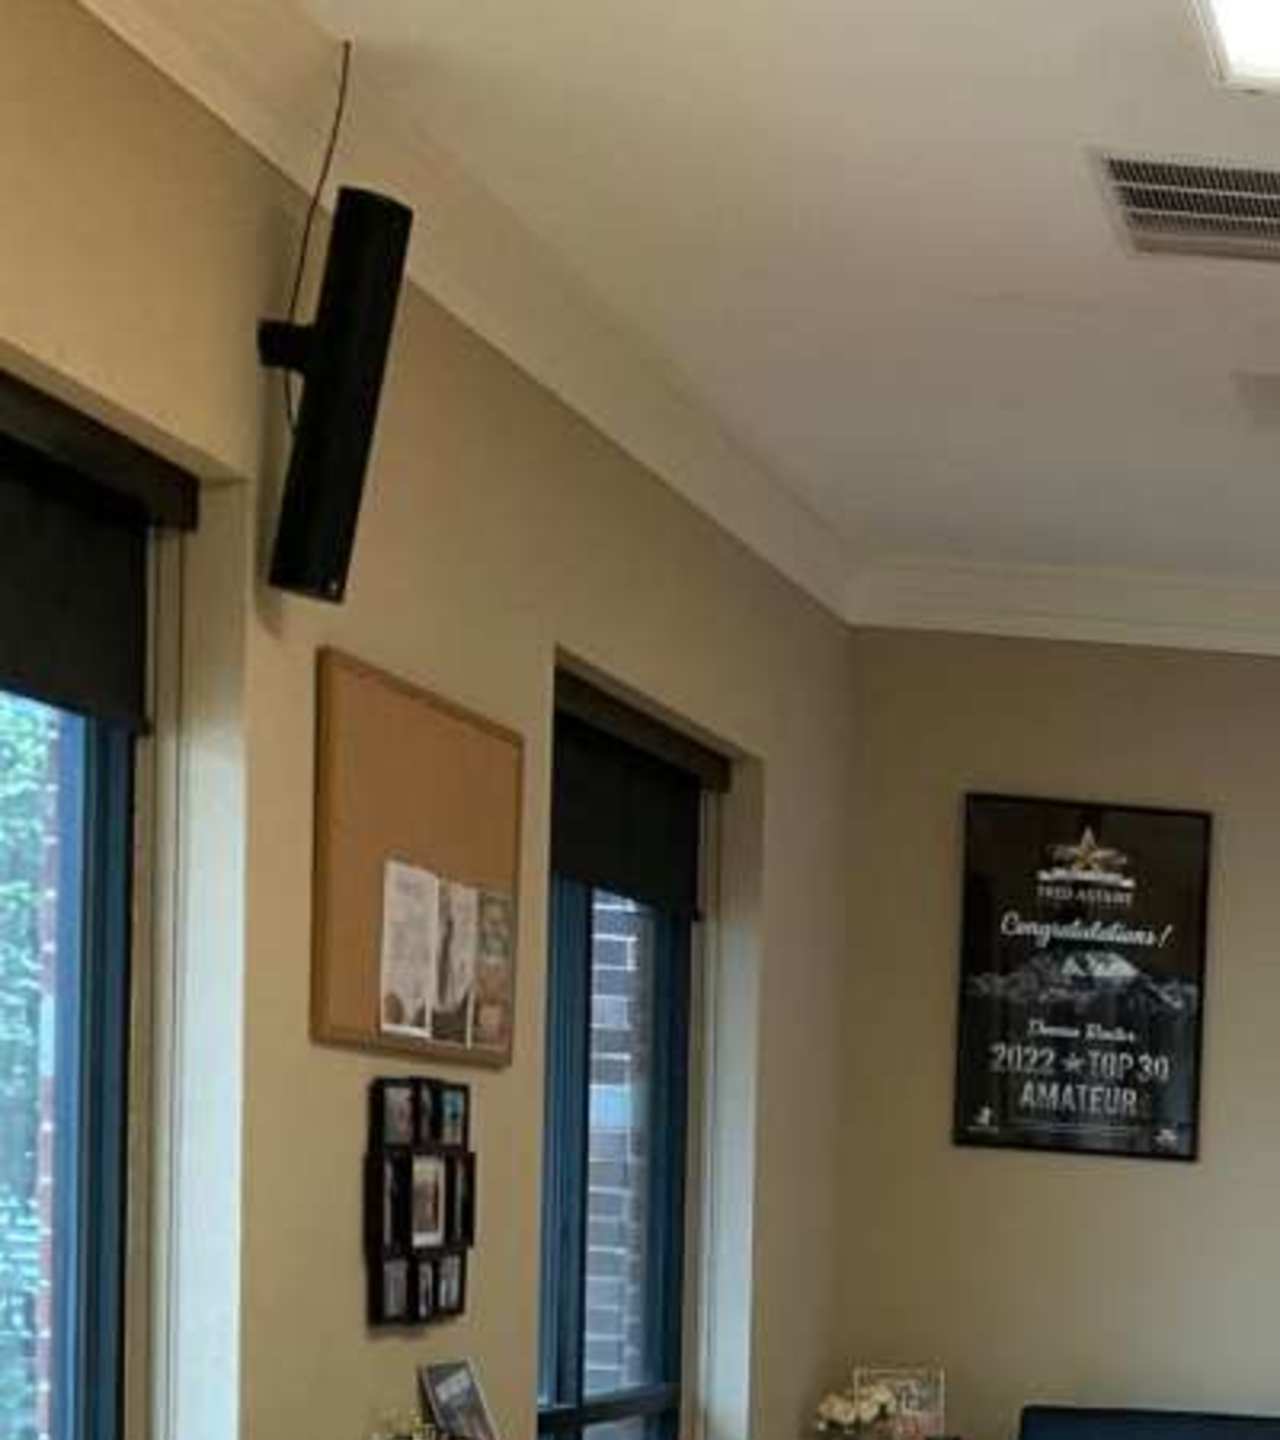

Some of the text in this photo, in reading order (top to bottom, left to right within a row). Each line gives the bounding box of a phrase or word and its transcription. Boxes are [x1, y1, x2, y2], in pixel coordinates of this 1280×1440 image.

[990, 1042, 1170, 1084] 2022 TOP 30
[1020, 1080, 1138, 1117] AMATEUR
